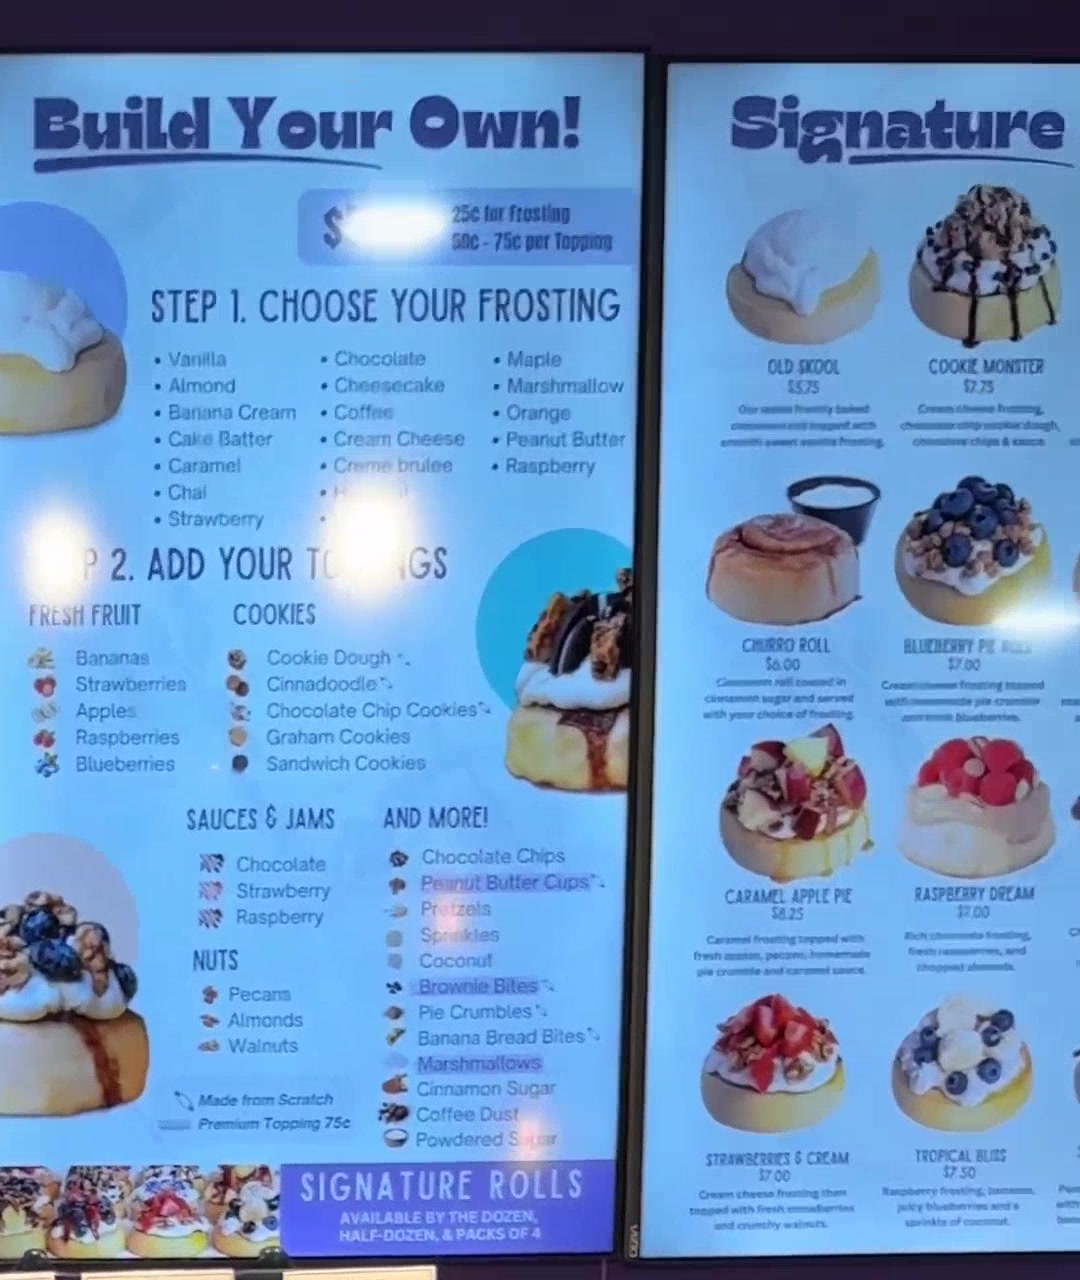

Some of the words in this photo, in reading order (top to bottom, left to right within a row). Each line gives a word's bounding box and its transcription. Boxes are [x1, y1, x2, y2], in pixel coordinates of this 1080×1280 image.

[34, 95, 209, 150] Build
[227, 95, 392, 150] Your
[409, 95, 580, 150] Own!
[732, 95, 1064, 164] Signature
[152, 288, 216, 324] STEP
[232, 288, 247, 324] 1.
[260, 288, 377, 324] CHOOSE
[392, 288, 466, 324] YOUR
[479, 288, 620, 324] FROSTING
[169, 351, 226, 369] Vanilla
[334, 350, 425, 368] Chocolate
[508, 350, 562, 371] Maple
[169, 377, 235, 395] Almond
[508, 377, 624, 395] Marshmallow
[169, 404, 233, 422] Banana
[238, 404, 296, 422] Cream
[334, 404, 393, 422] Coffee
[507, 404, 571, 424] Orange
[169, 457, 240, 475] Caramel
[506, 457, 595, 479] Raspberry
[169, 510, 264, 530] Strawberry
[111, 548, 134, 583] 2.
[148, 548, 205, 583] ADD
[220, 548, 291, 583] YOUR
[29, 603, 84, 626] FRESH
[90, 603, 140, 626] FRUIT
[233, 603, 316, 625] COOKIES
[267, 649, 328, 667] Cookie
[334, 649, 391, 670] Dough
[267, 675, 377, 693] Cinnadoodle
[76, 755, 174, 773] Blueberries
[187, 806, 257, 832] SAUCES
[285, 806, 334, 832] JAMS
[384, 806, 420, 830] AND
[429, 806, 488, 830] MORE!
[237, 855, 325, 873] Chocolate
[237, 881, 331, 902] Strawberry
[237, 908, 323, 928] Raspberry
[193, 949, 238, 972] NUTS
[418, 1054, 541, 1072] Marshmallows
[417, 1080, 498, 1098] Cinnamon
[505, 1080, 555, 1101] Sugar
[301, 1169, 471, 1203] SIGNATURE
[490, 1169, 582, 1203] ROLLS
[340, 1210, 422, 1228] AVAILABLE
[426, 1210, 445, 1228] BY
[450, 1210, 475, 1228] THE
[480, 1210, 537, 1228] DOZEN,
